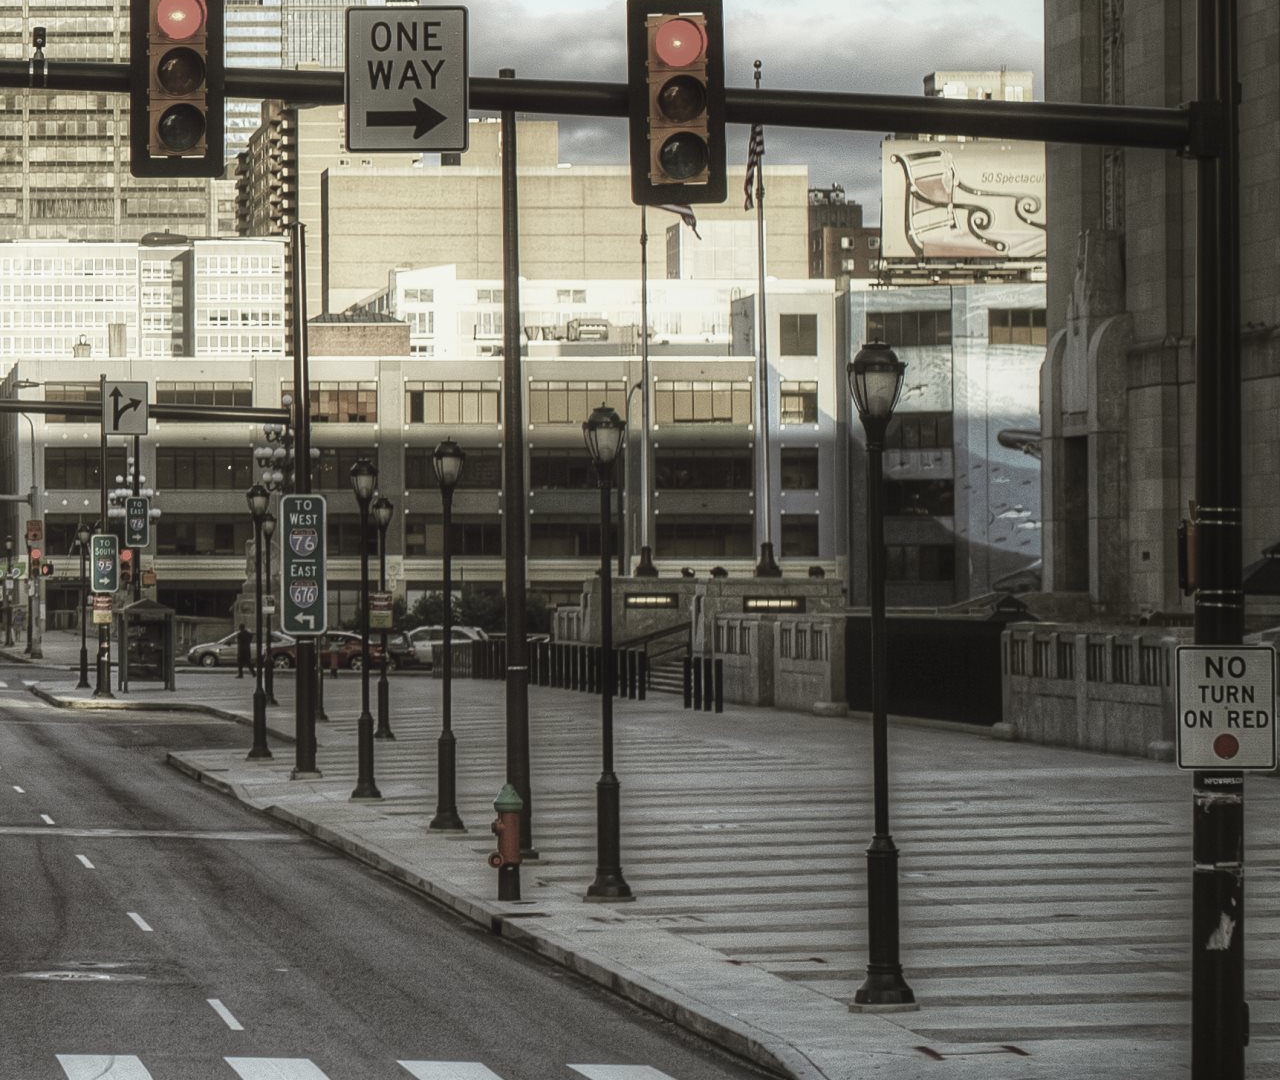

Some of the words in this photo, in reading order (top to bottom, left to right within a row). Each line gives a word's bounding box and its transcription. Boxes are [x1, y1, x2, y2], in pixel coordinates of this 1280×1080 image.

[370, 21, 443, 52] ONE
[367, 59, 446, 90] WAY
[981, 172, 994, 184] 50
[295, 500, 313, 511] TO
[131, 519, 144, 529] 76
[289, 513, 318, 526] WEST
[292, 536, 316, 551] 76
[95, 547, 115, 556] SOUTH
[98, 560, 113, 571] 95
[290, 564, 318, 577] EAST
[294, 586, 315, 603] 676
[1205, 655, 1246, 679] NO
[1198, 685, 1255, 703] TURN
[1184, 710, 1213, 729] ON
[1227, 710, 1269, 729] RED
